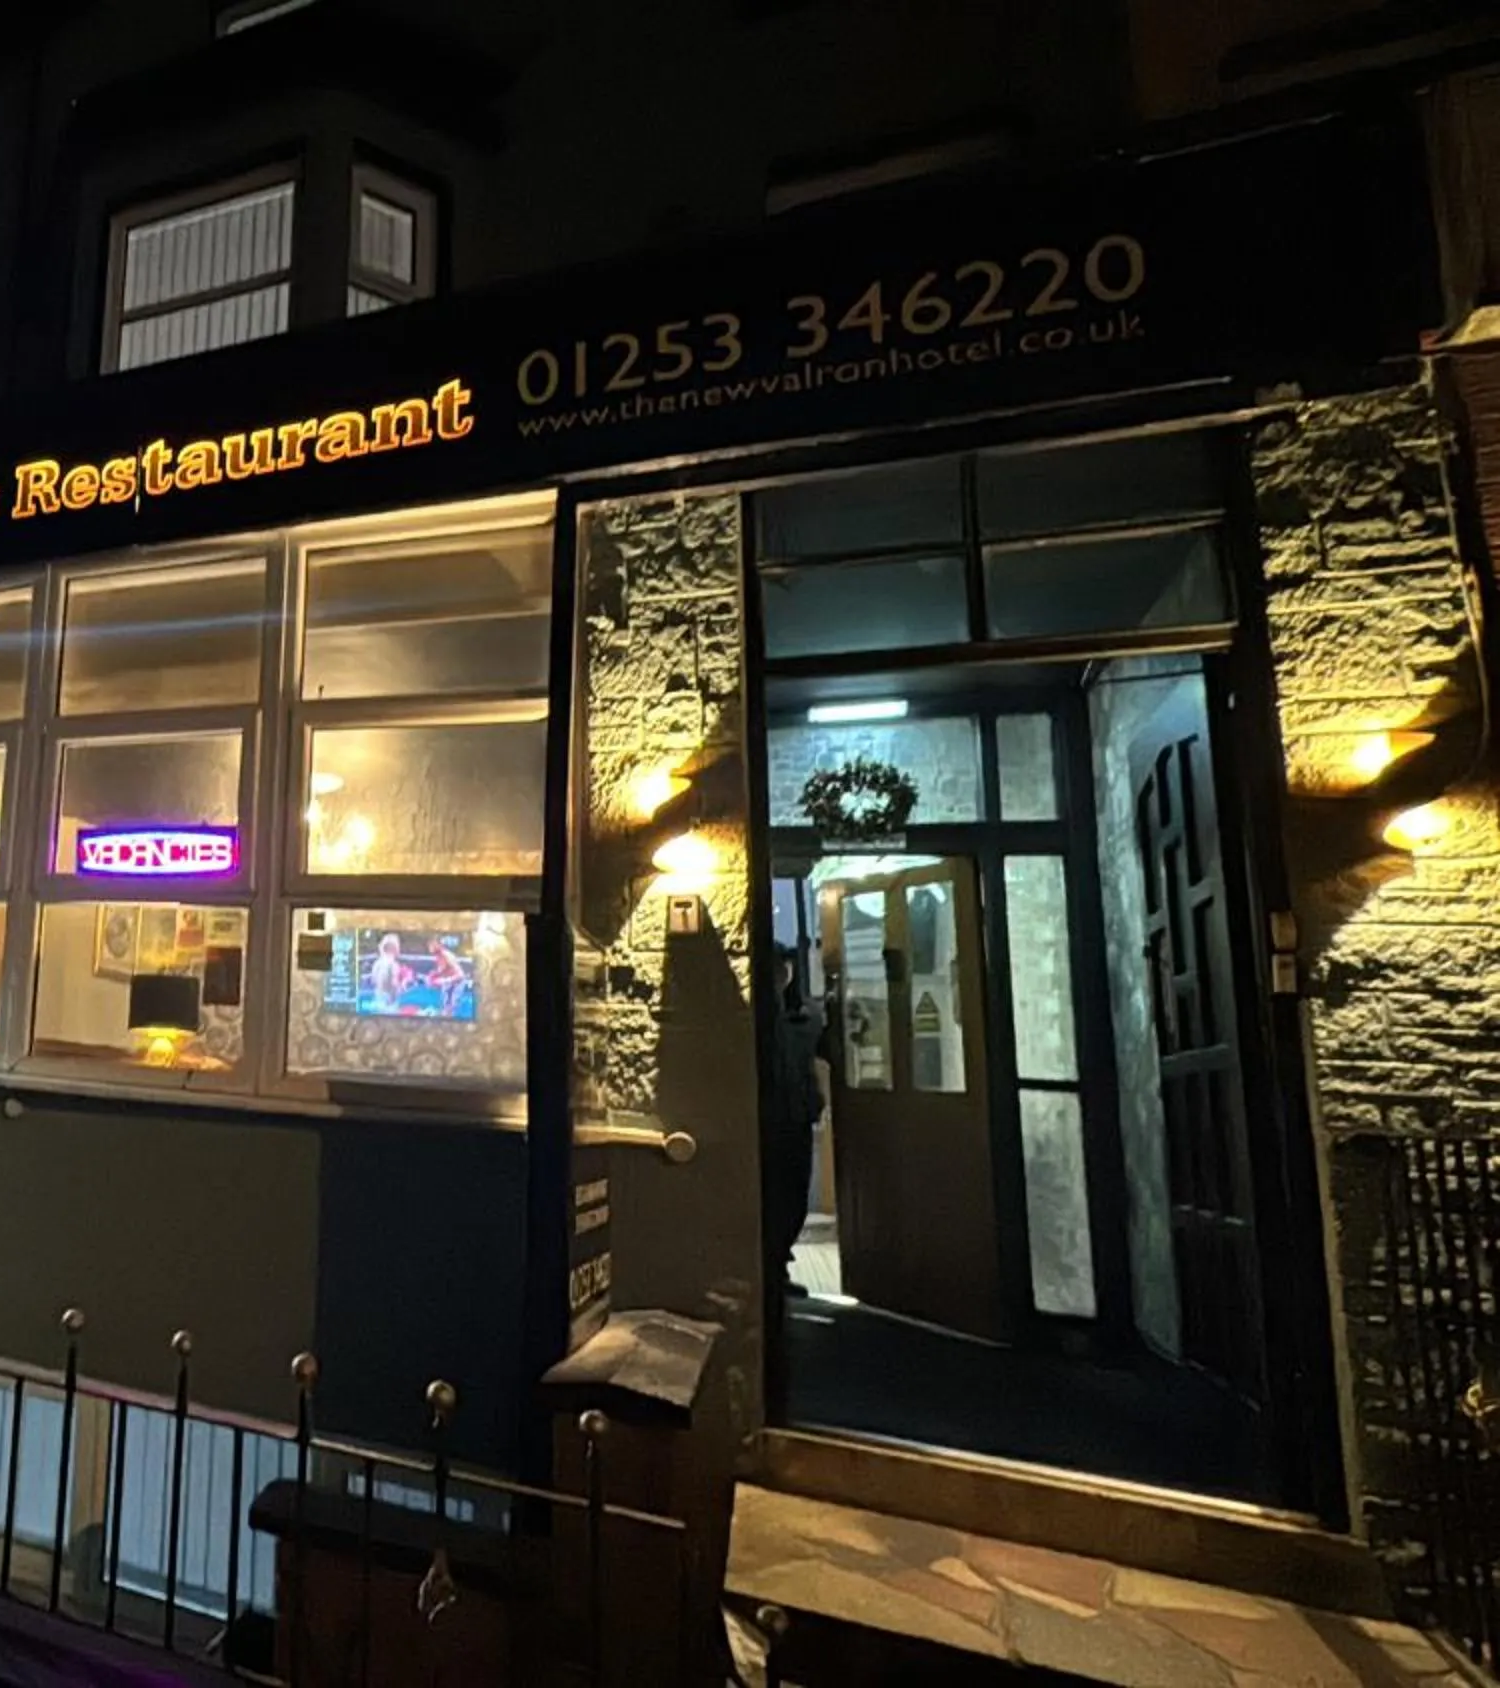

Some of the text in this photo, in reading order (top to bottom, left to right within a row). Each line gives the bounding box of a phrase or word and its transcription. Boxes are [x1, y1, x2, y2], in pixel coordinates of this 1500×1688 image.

[516, 235, 1147, 405] 01253 346220
[518, 309, 1146, 437] www.thenewvalronhotel.co.uk
[12, 378, 474, 518] Restaurant
[83, 838, 232, 868] VACANCIES
